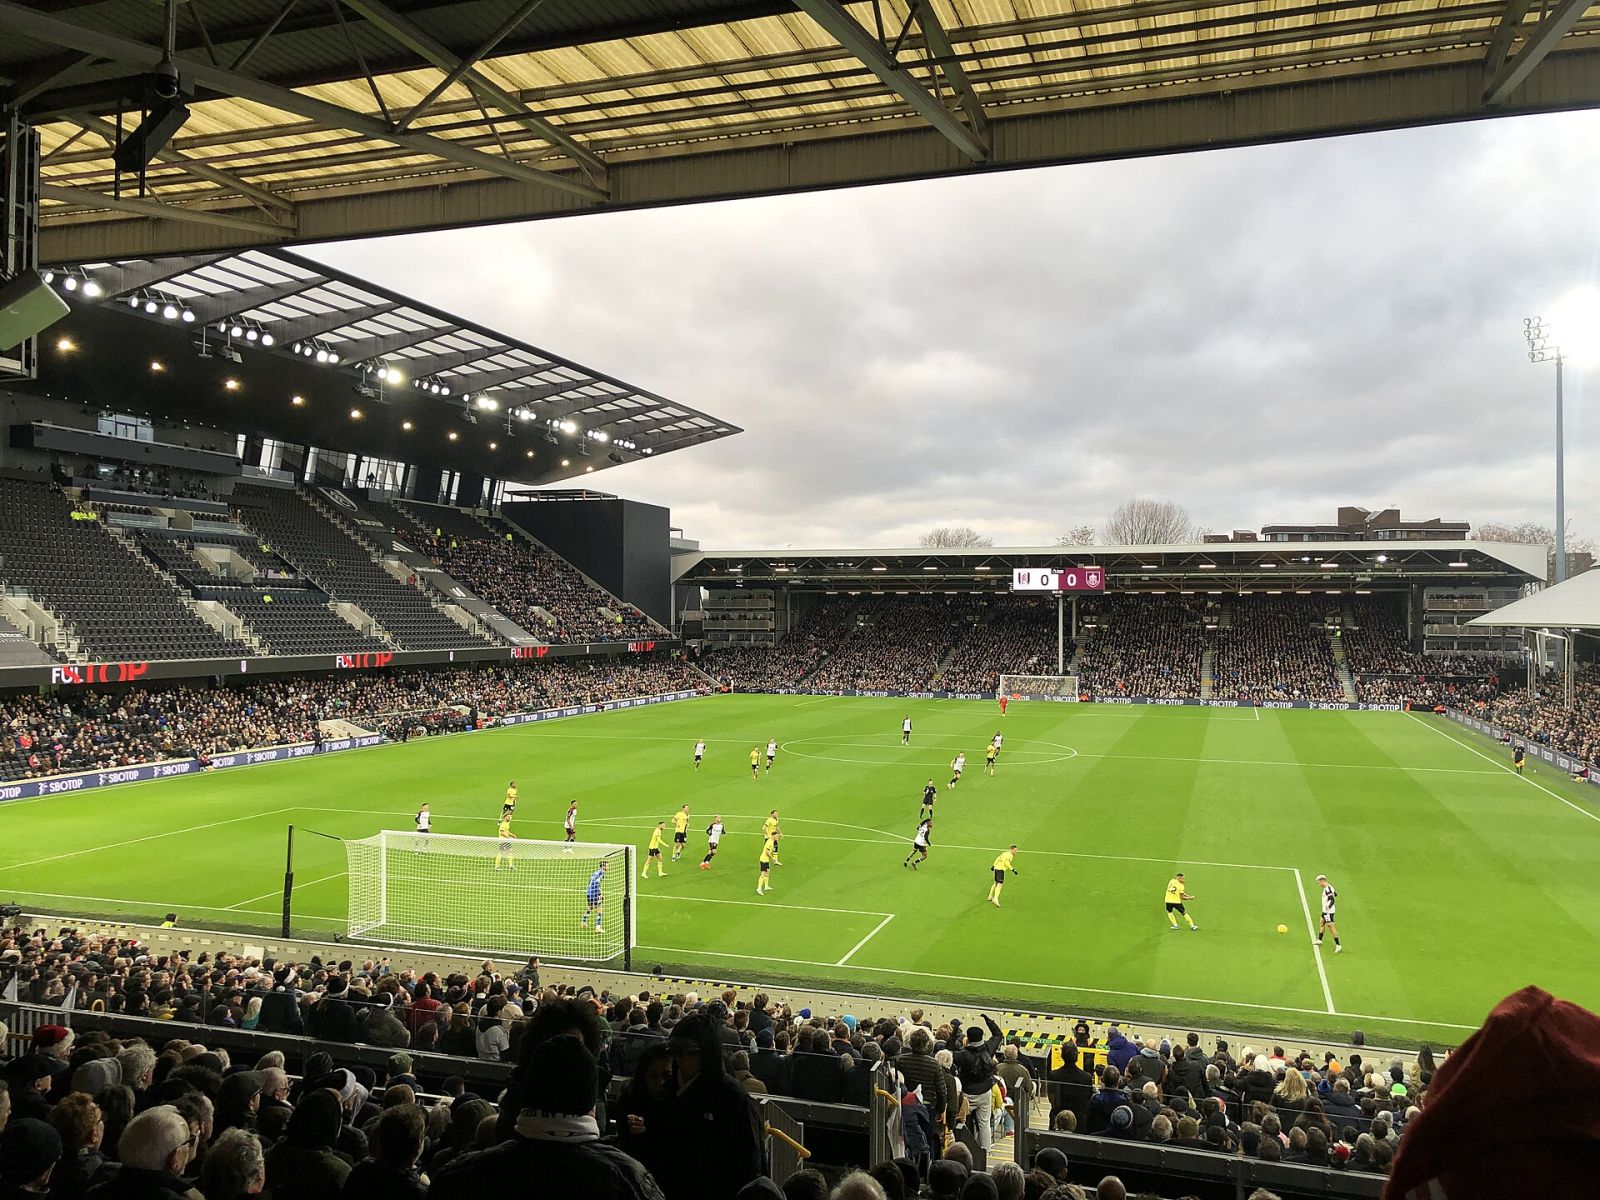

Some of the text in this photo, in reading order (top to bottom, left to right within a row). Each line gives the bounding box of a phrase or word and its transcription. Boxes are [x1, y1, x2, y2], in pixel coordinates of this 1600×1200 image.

[1041, 574, 1049, 586] 0
[1067, 573, 1077, 587] 0
[1263, 701, 1294, 709] SBOTOP
[1318, 702, 1350, 711] SBOTOP
[1368, 703, 1400, 712] SBOTOP
[254, 750, 278, 762] SBOTOP
[162, 763, 190, 777] SBOTOP
[108, 770, 139, 783] SBOTOP
[49, 779, 83, 793] SBOTOP
